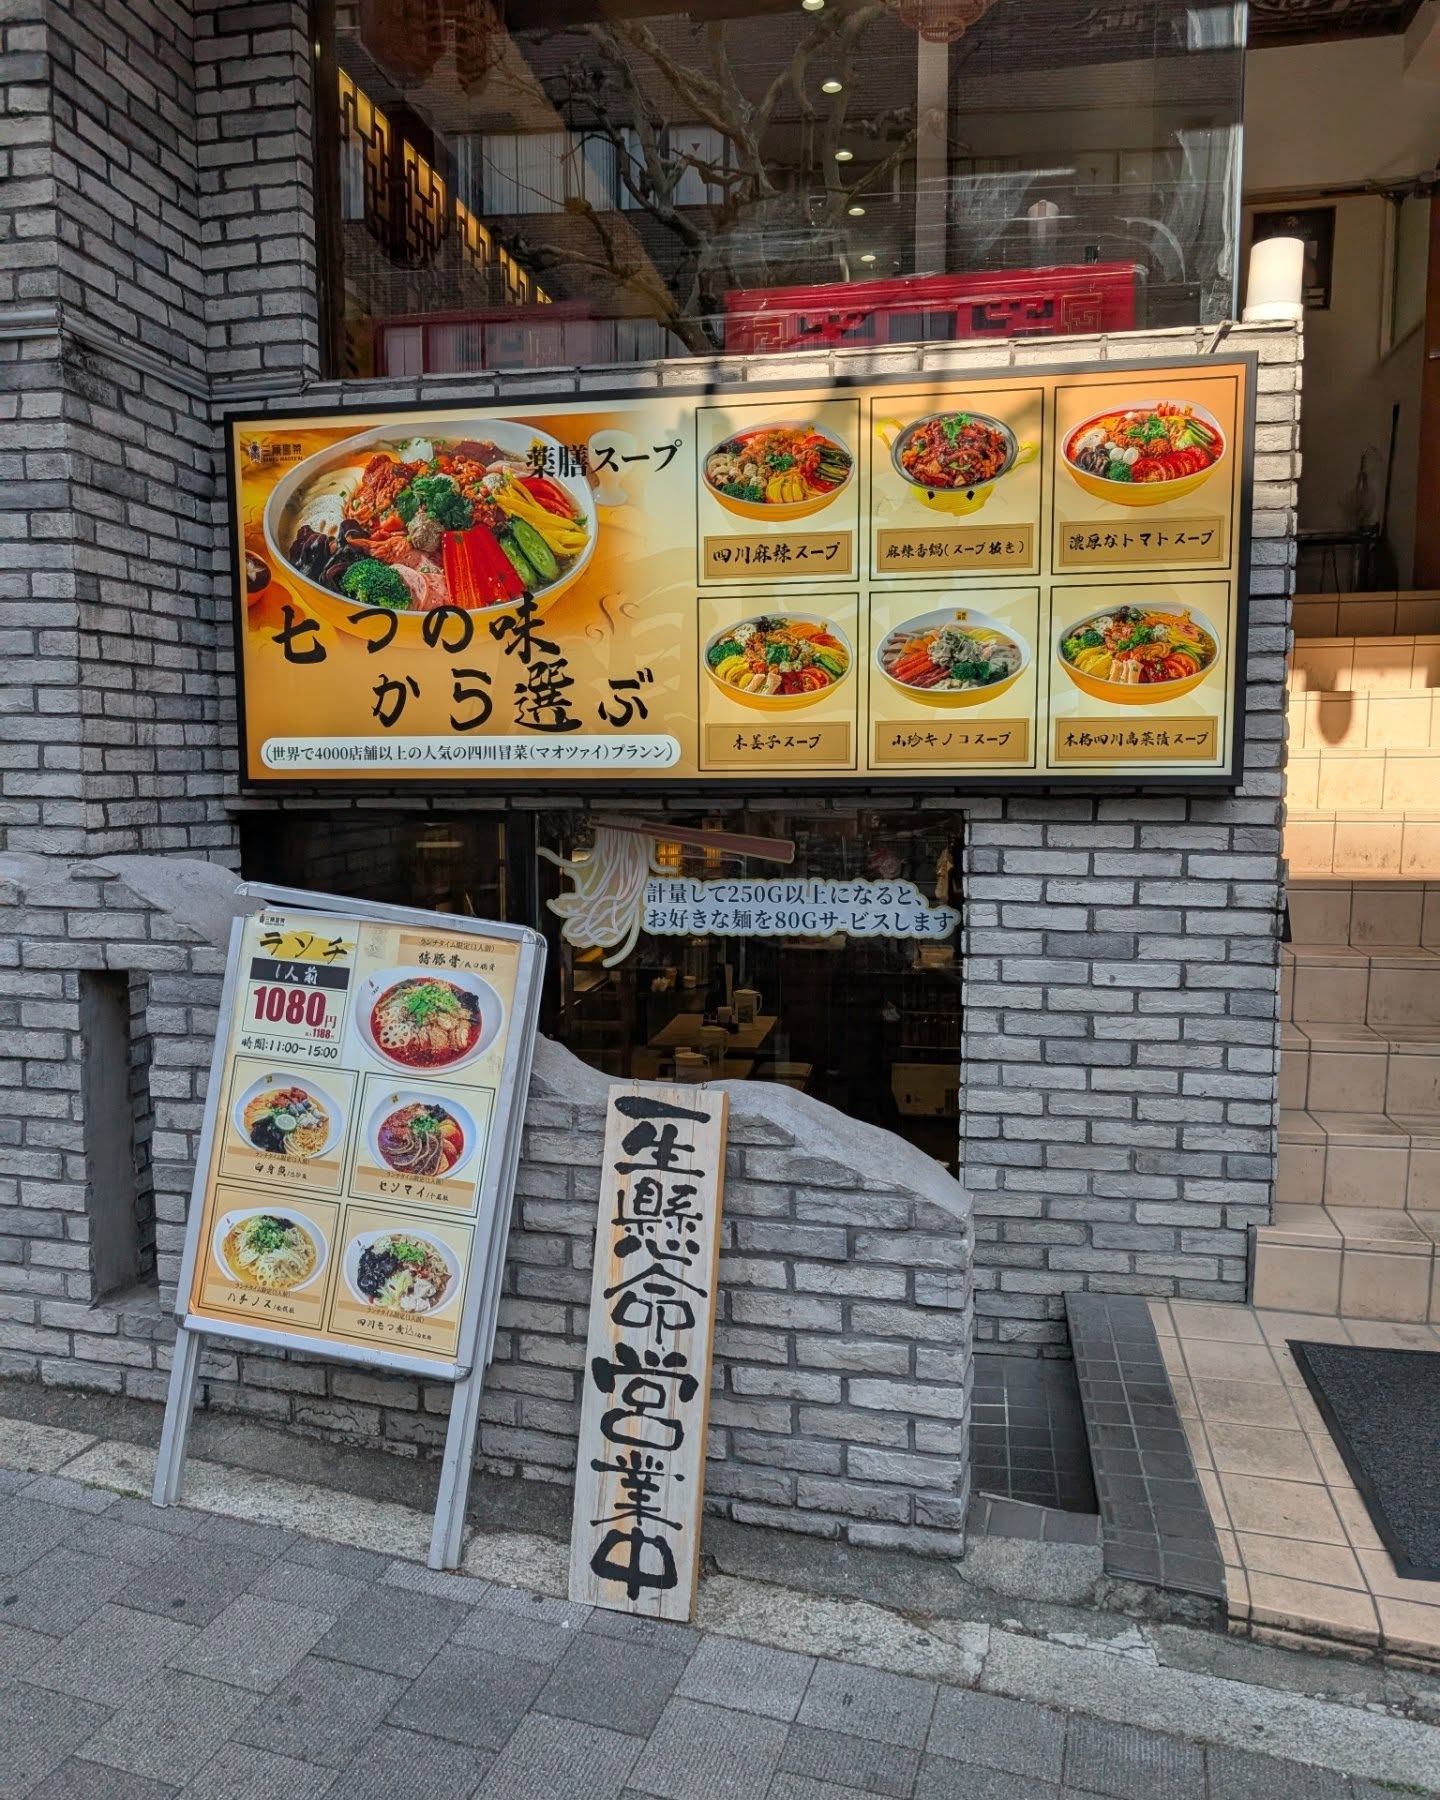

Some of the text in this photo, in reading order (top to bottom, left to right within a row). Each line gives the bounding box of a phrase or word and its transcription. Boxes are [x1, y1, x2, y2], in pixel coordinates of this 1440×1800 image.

[526, 438, 683, 479] 薬膳スープ
[713, 541, 841, 564] 四川麻辣スープ
[1069, 529, 1215, 551] 濃厚なトマトスープ
[271, 592, 562, 665] 七つの味
[370, 658, 654, 733] から選ぶ
[646, 882, 926, 906] 計量して250G以上になると、
[590, 1095, 711, 1600] 一生懸命営業中
